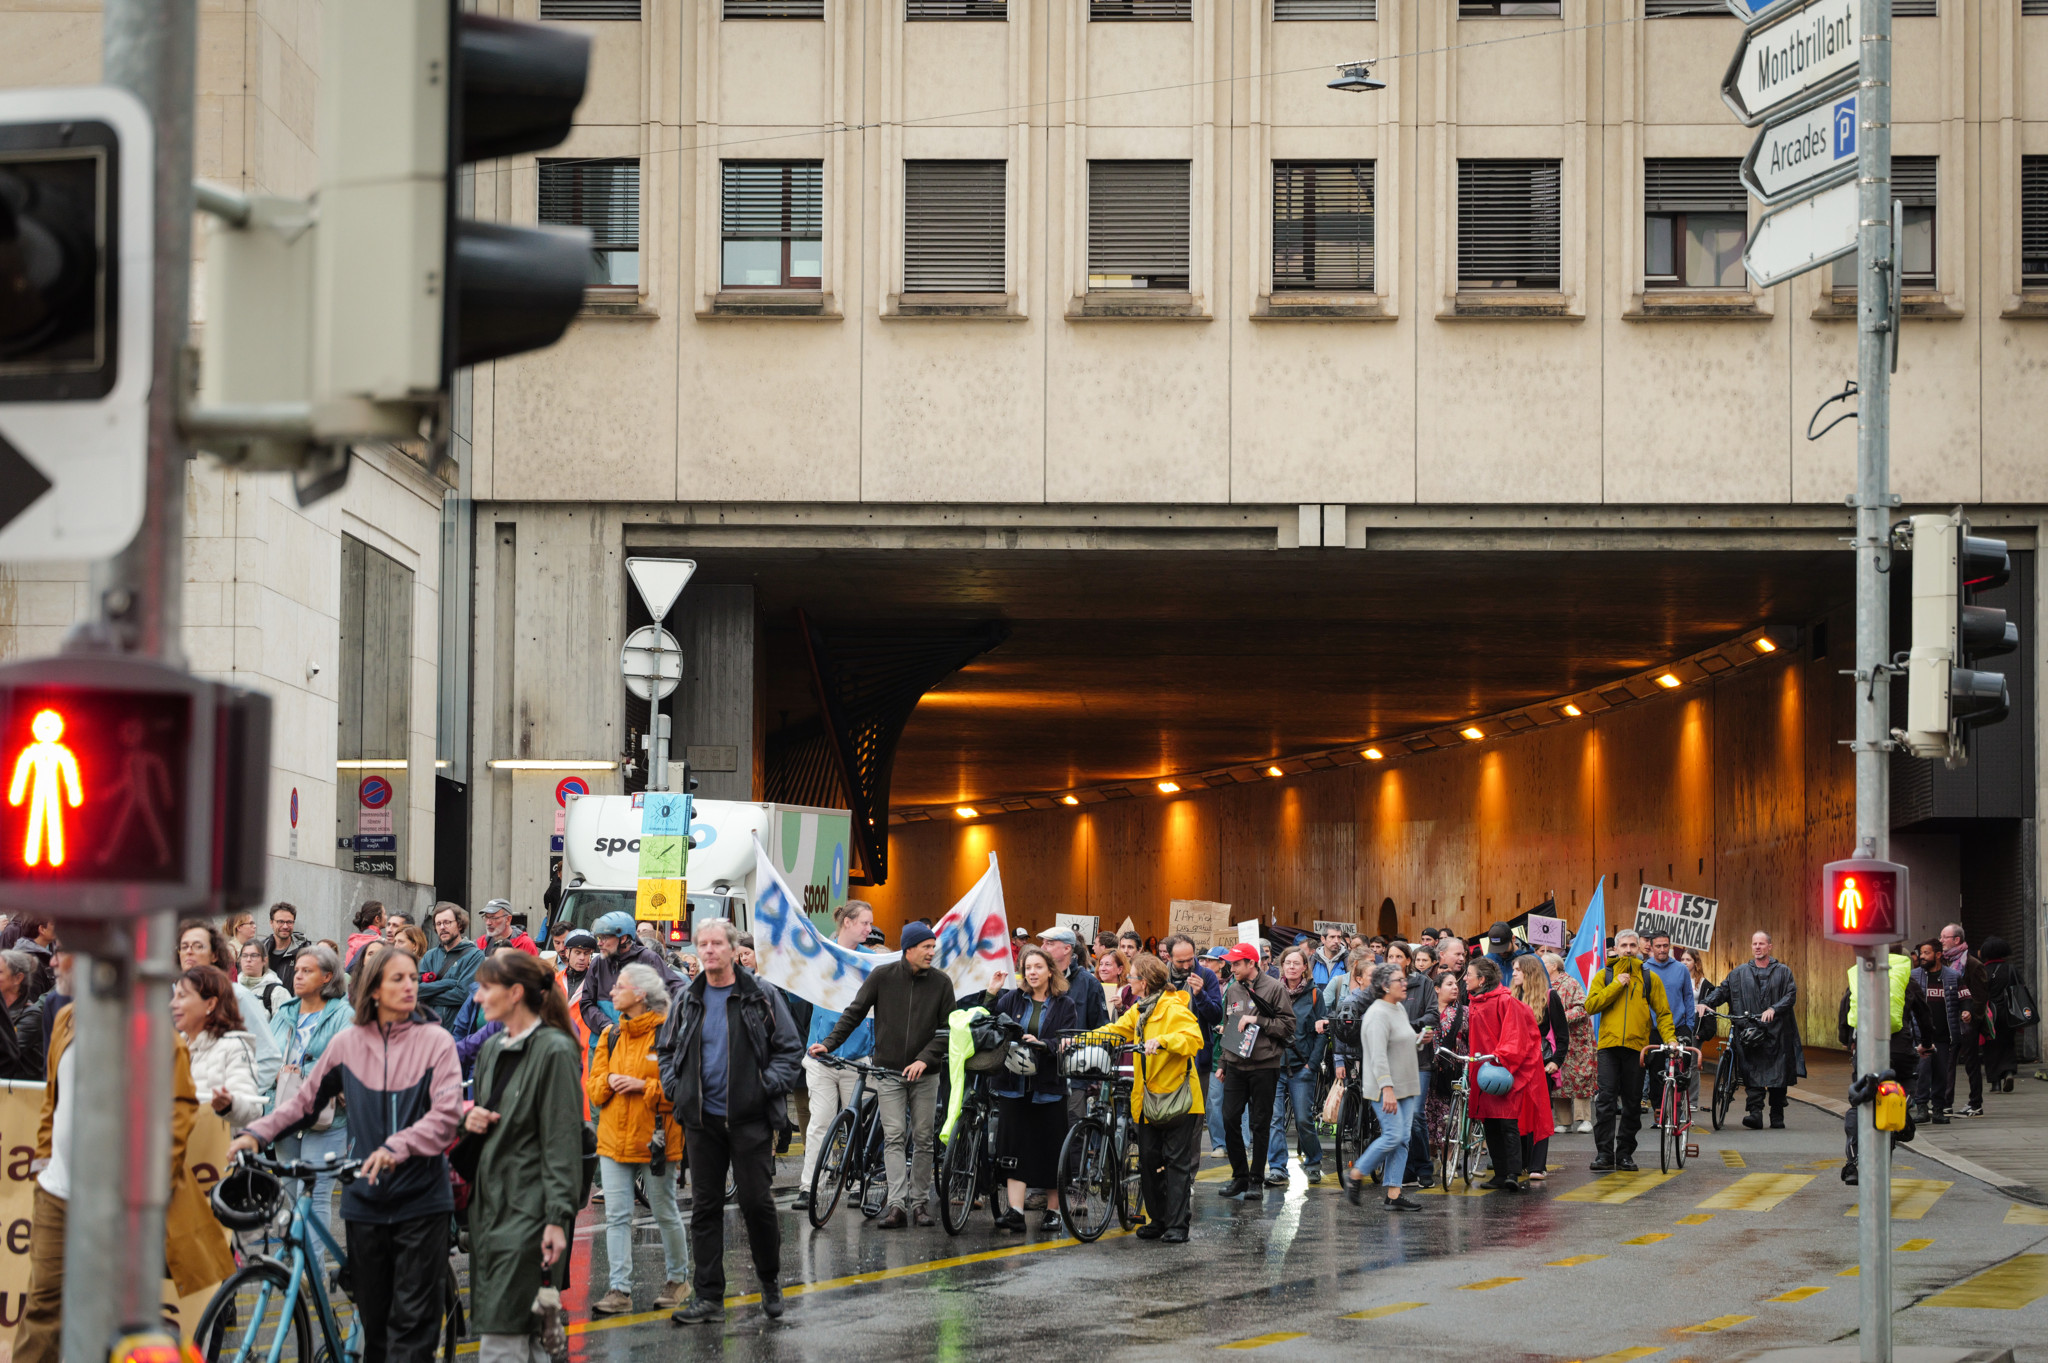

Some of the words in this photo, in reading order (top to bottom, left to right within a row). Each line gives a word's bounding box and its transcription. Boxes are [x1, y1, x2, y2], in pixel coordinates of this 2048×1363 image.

[1758, 5, 1852, 92] Montbrillant
[1771, 123, 1827, 175] Arcades
[1840, 117, 1850, 151] P
[594, 838, 641, 857] spo
[803, 875, 830, 918] spool
[1640, 886, 1682, 914] L'ART
[1680, 895, 1718, 920] EST
[1218, 936, 1239, 946] L'ART
[1635, 911, 1710, 950] FONDAMENTAL
